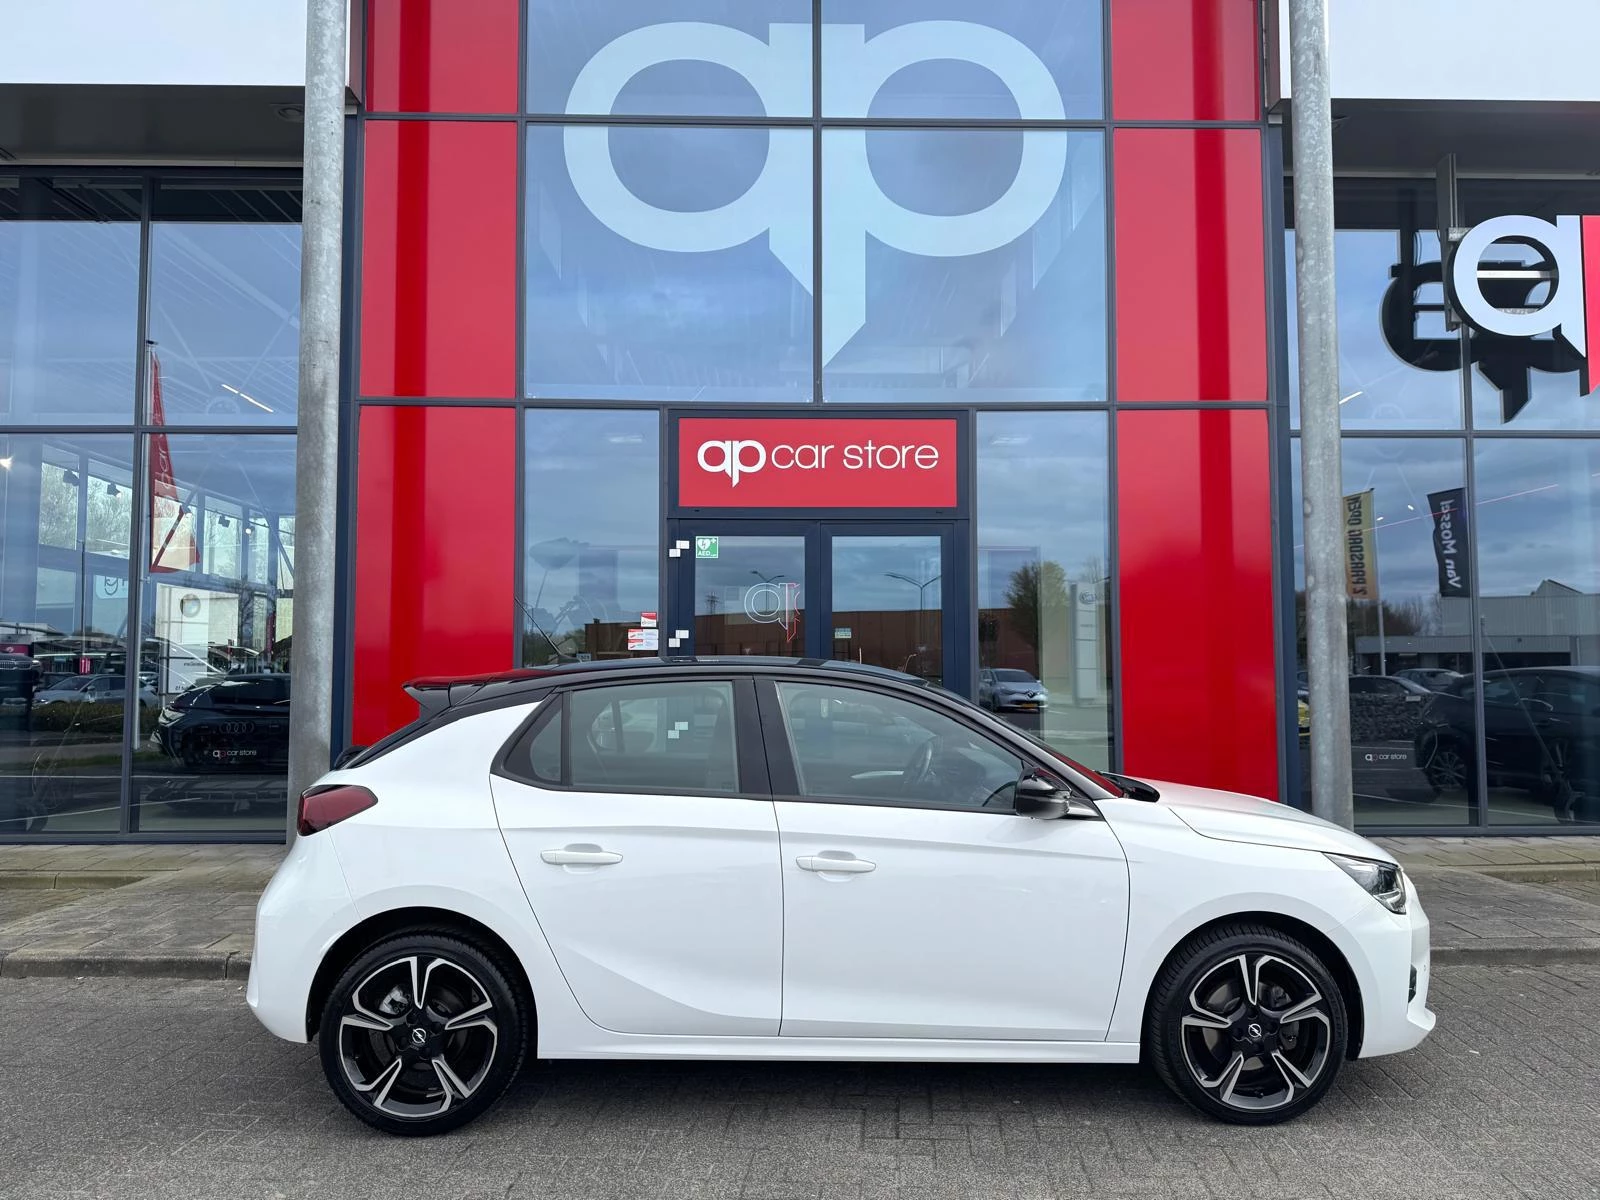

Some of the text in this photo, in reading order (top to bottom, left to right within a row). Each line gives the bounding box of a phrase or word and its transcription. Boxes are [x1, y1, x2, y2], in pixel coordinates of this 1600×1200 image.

[564, 20, 1067, 368] ap
[1453, 214, 1600, 394] a
[697, 439, 939, 488] ap car store
